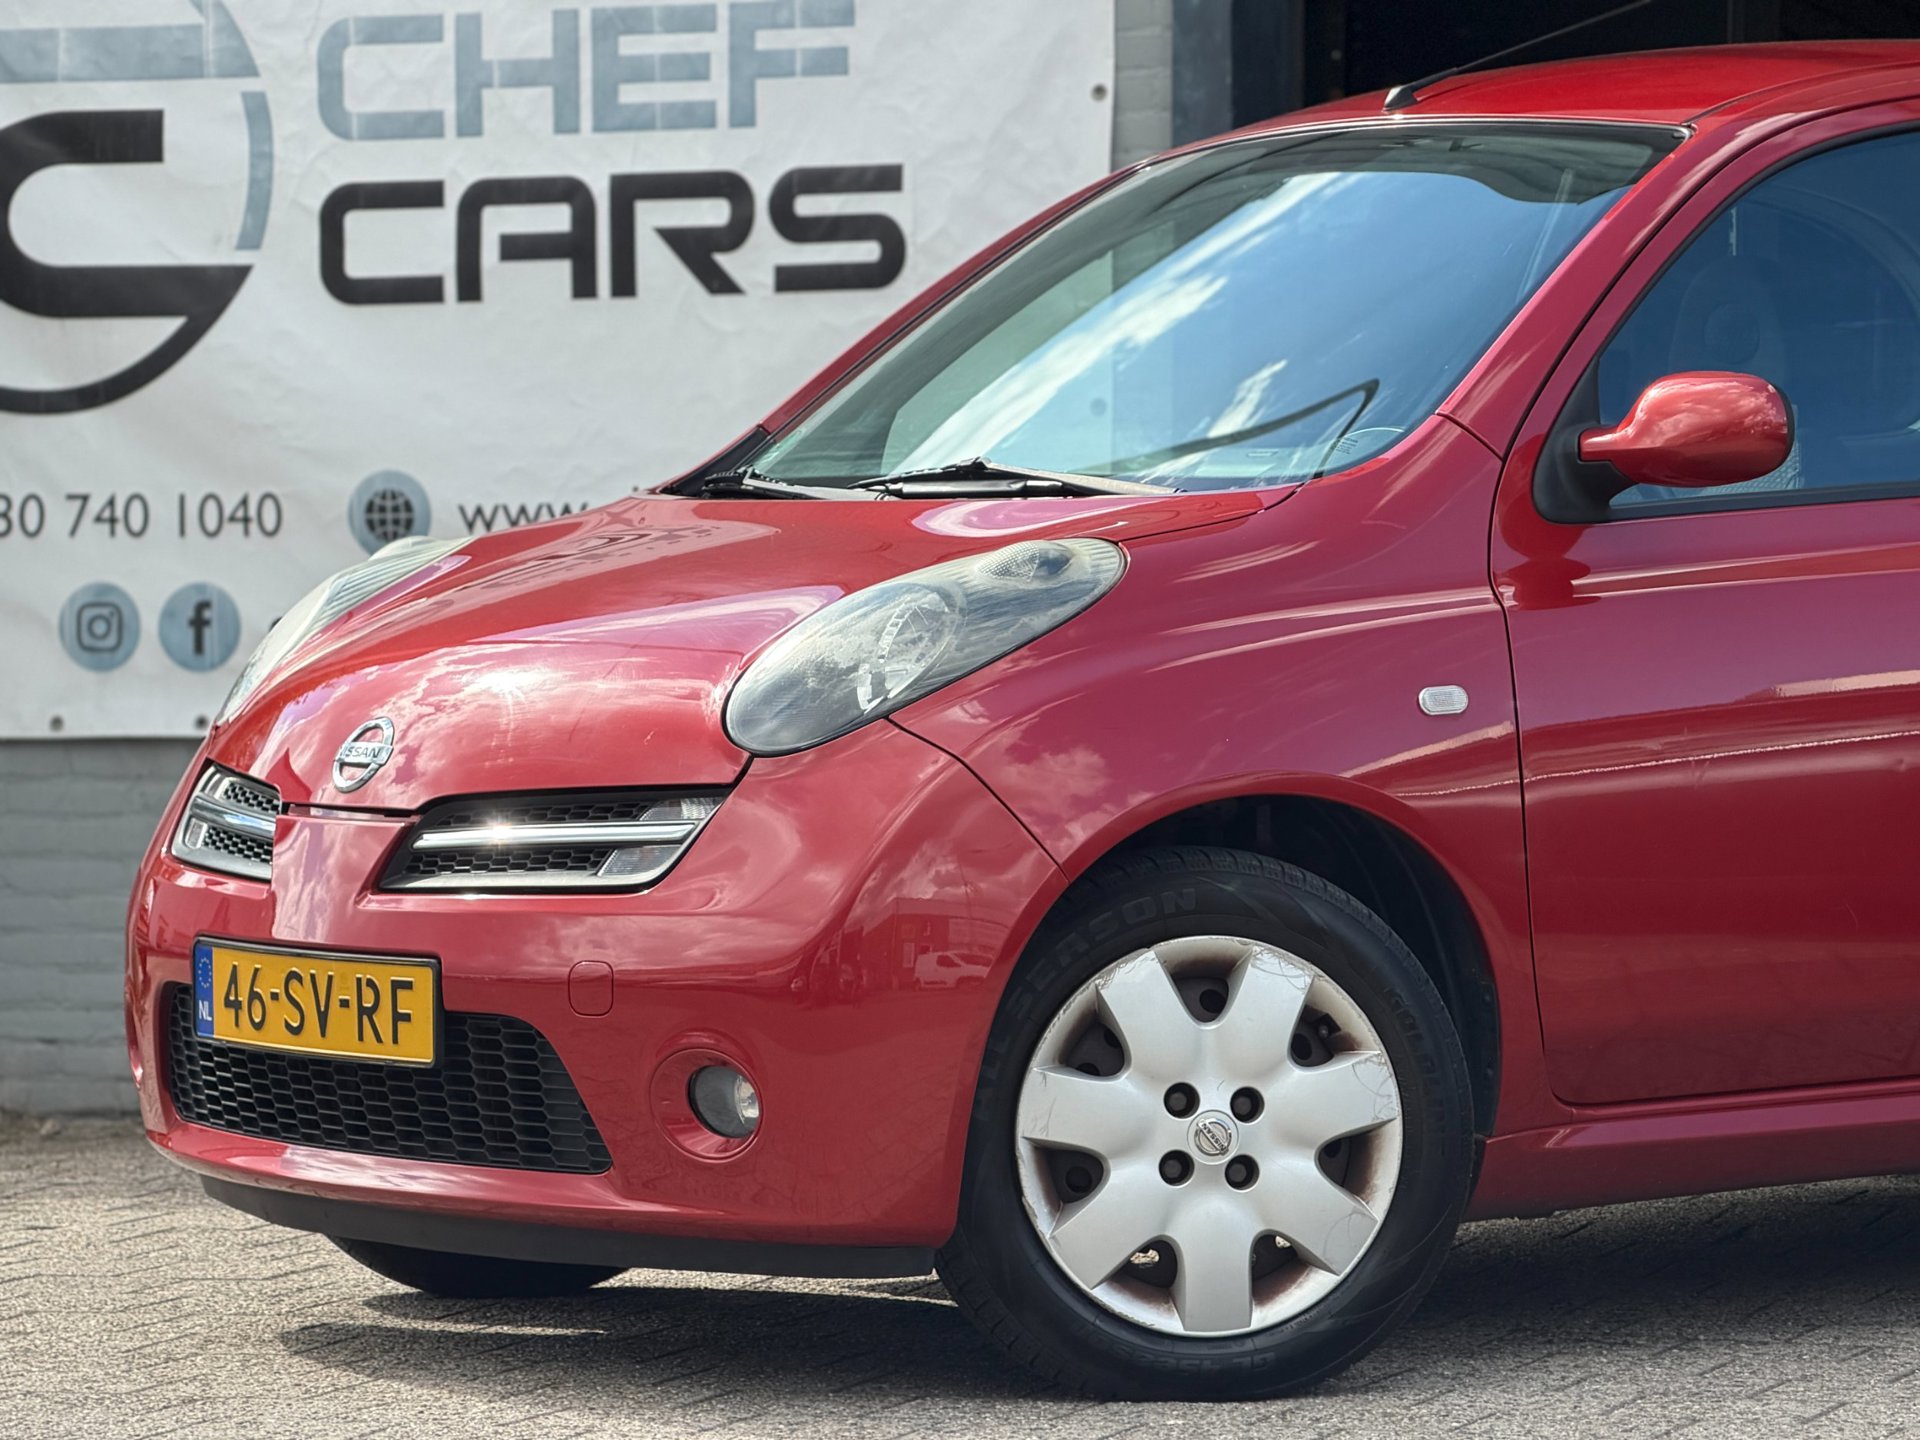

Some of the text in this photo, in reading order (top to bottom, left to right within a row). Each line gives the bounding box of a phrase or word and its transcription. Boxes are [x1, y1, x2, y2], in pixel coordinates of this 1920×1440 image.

[317, 0, 856, 141] CHEF
[320, 164, 906, 304] CARS
[65, 493, 149, 538] 740
[178, 492, 282, 538] 1040
[223, 961, 415, 1045] 46-SV-RF
[1002, 887, 1194, 1022] SEASON
[198, 999, 213, 1022] NL
